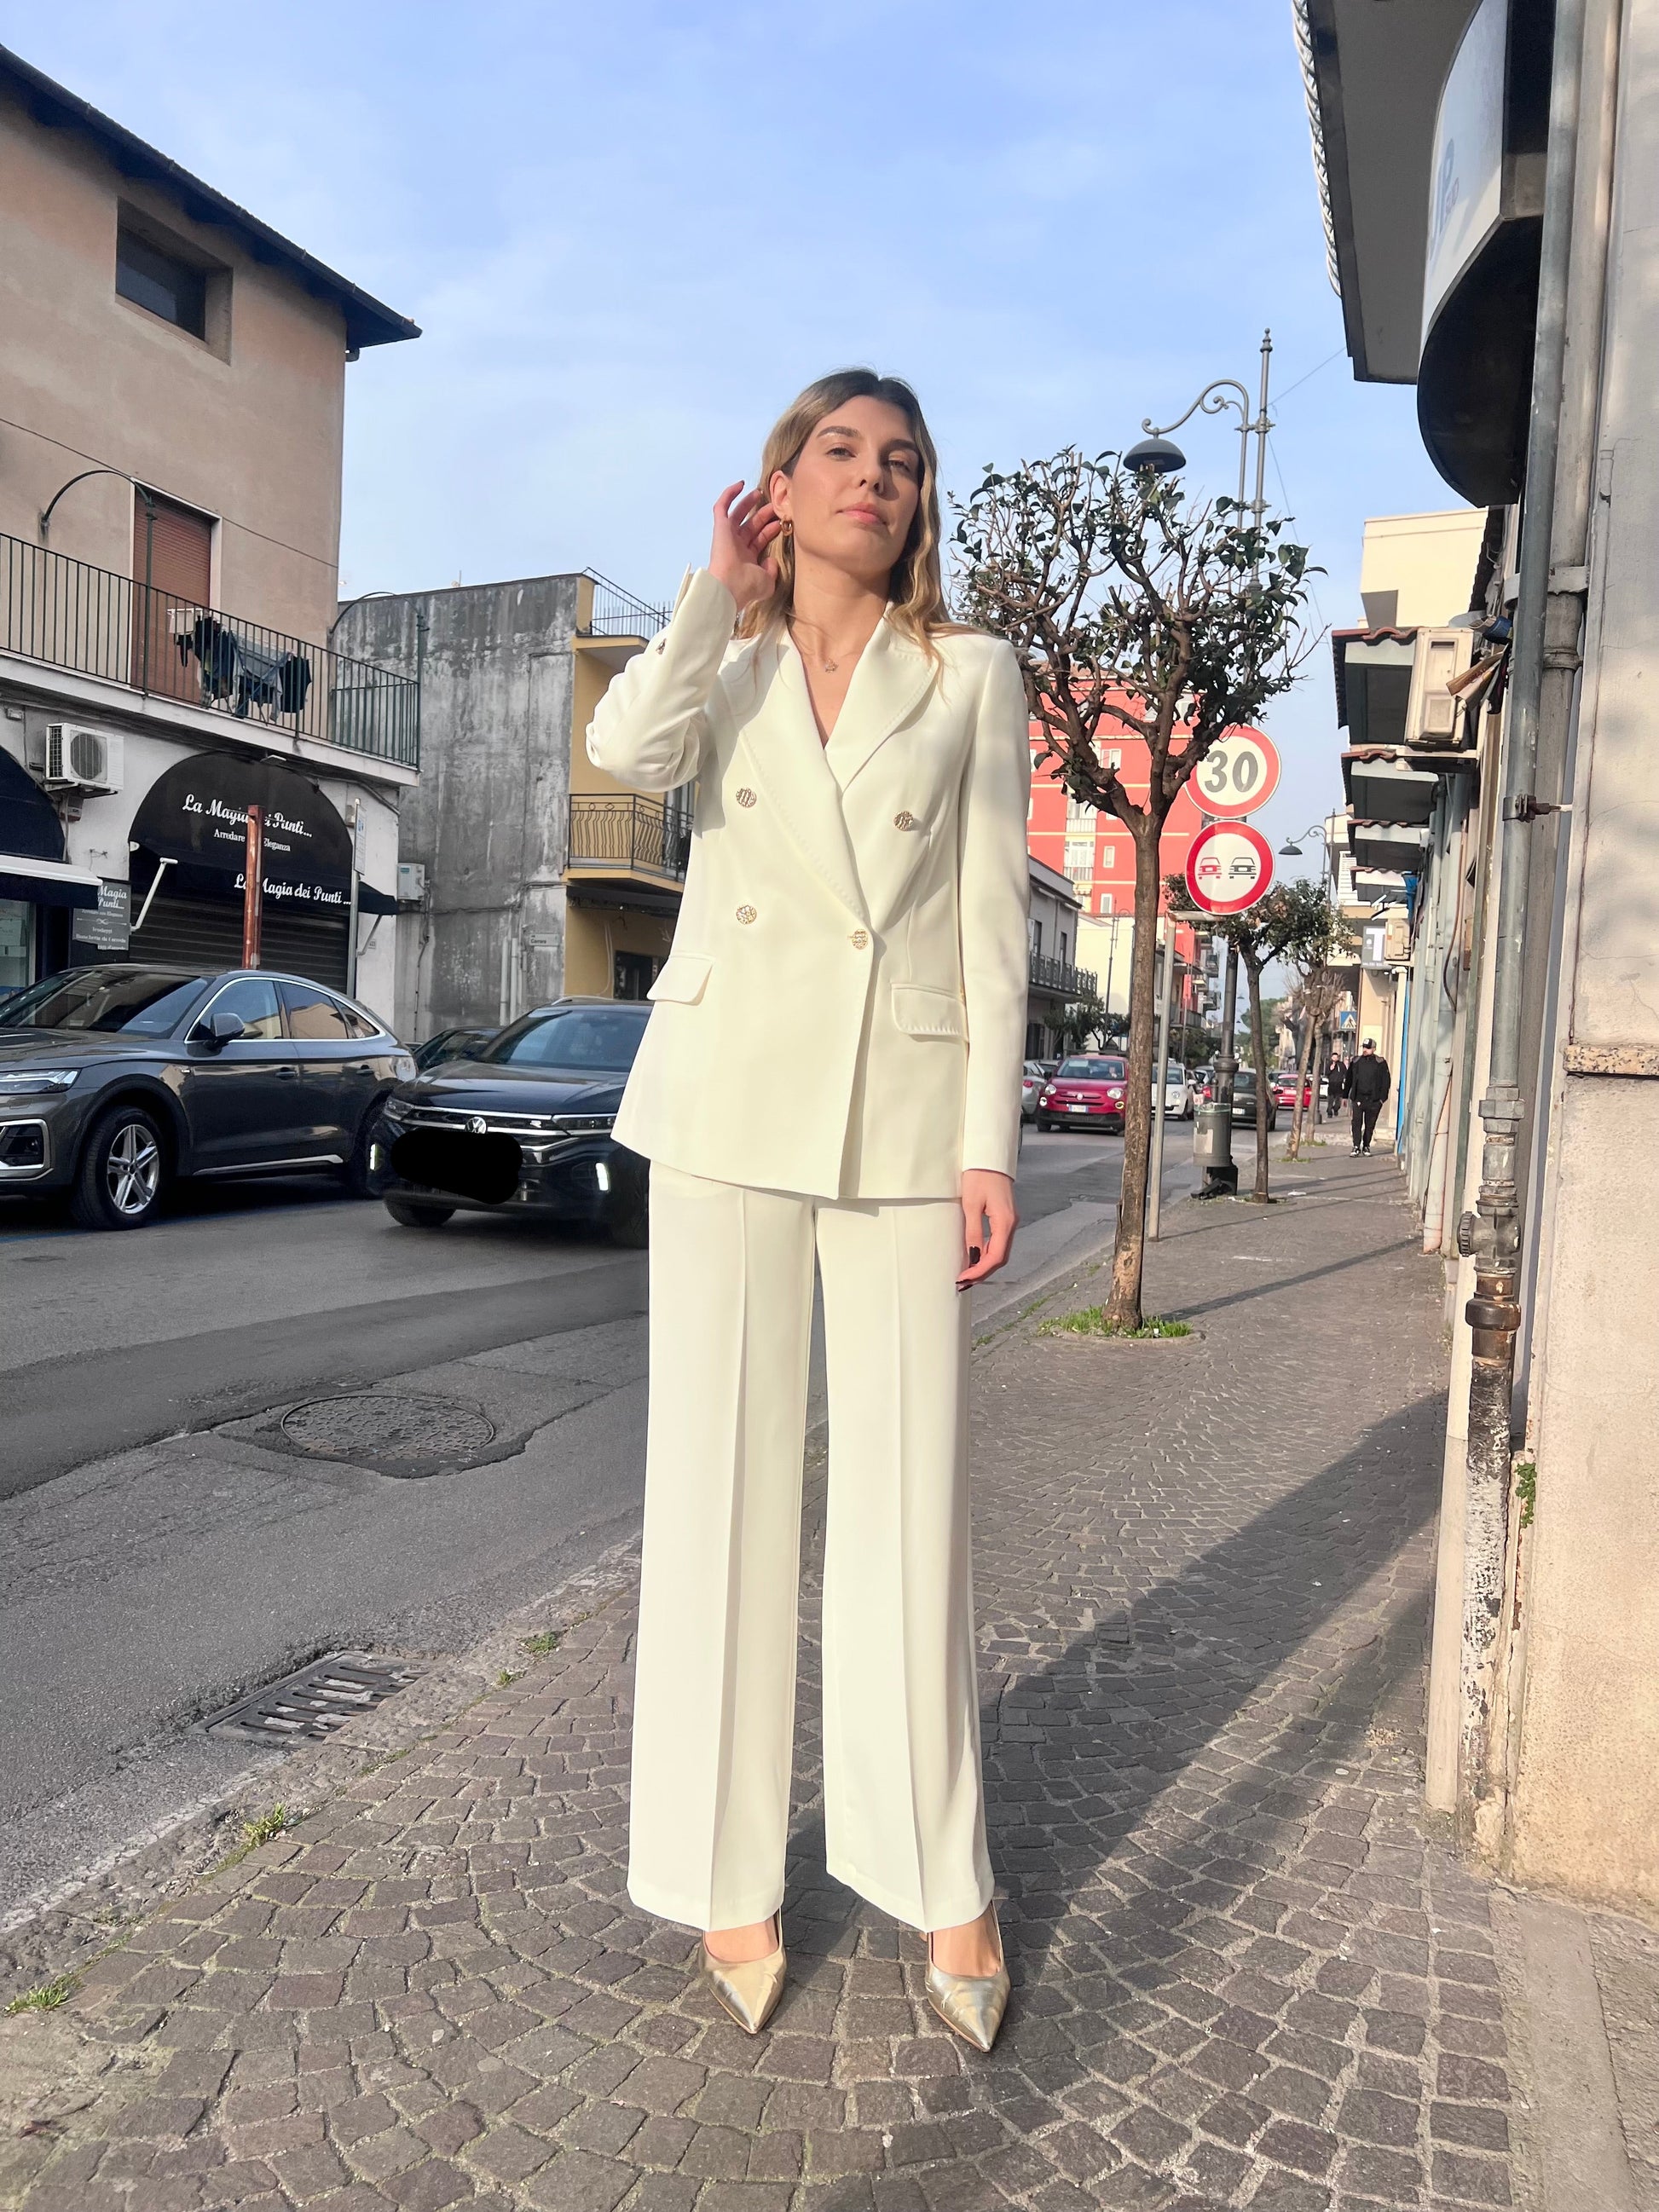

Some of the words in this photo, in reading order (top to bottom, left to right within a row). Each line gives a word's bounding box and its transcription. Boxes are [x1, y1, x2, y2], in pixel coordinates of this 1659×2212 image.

[1204, 750, 1258, 793] 30
[182, 794, 203, 813] La
[214, 828, 246, 842] Arredare
[294, 883, 310, 898] dei
